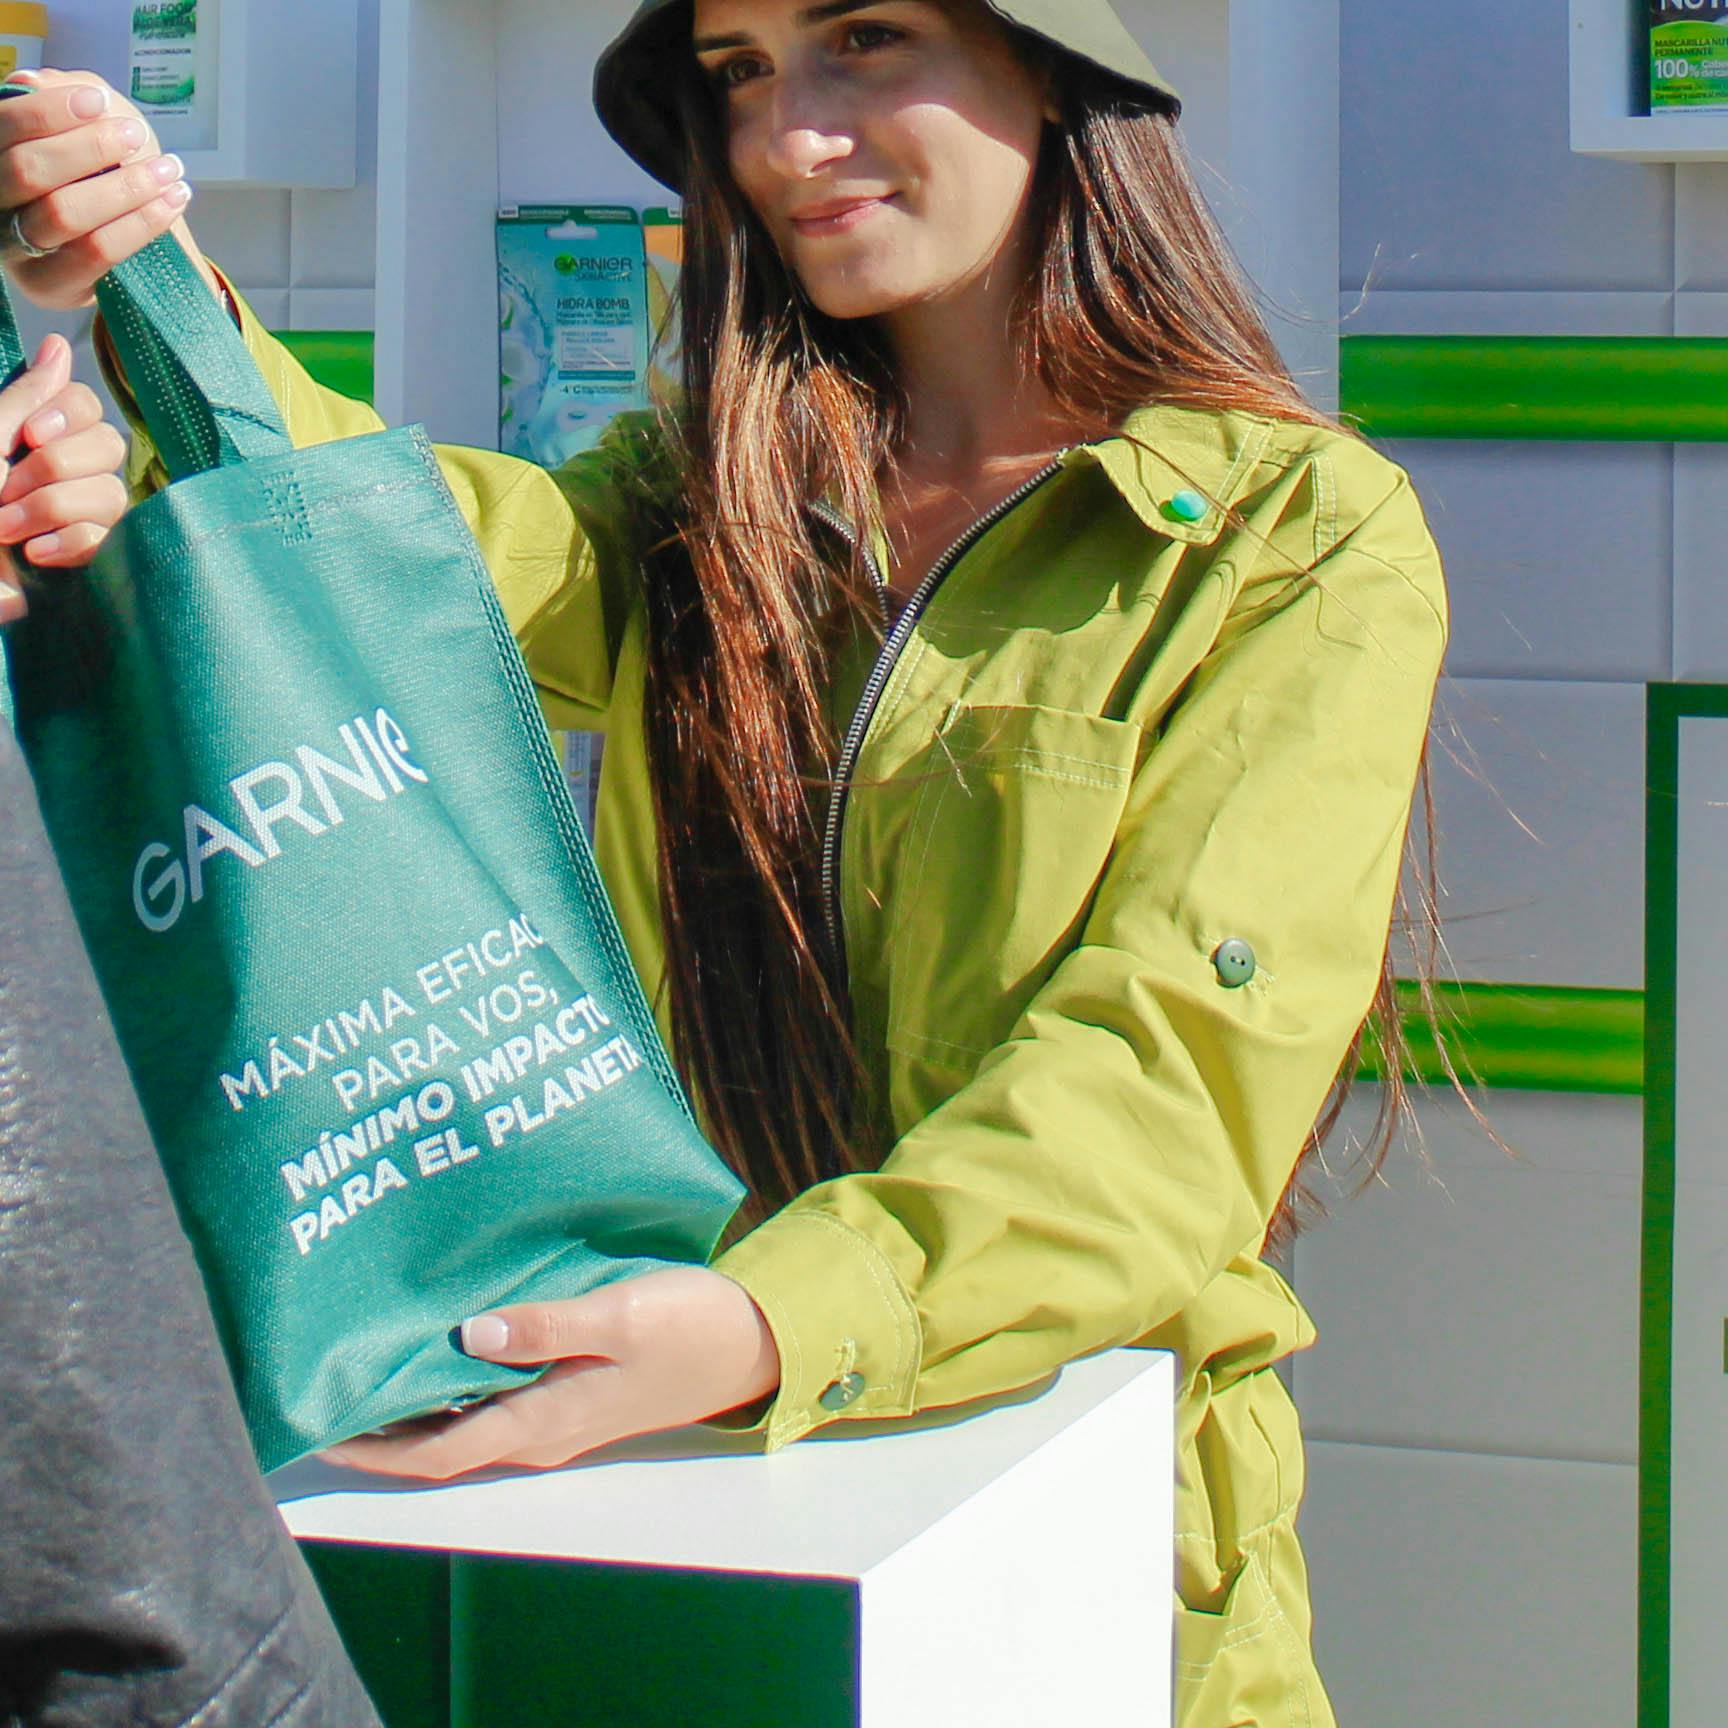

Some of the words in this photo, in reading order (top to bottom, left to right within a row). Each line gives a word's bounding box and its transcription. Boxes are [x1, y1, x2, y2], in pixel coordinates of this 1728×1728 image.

[554, 257, 632, 271] GARNIER
[557, 298, 594, 310] HIDRA
[595, 298, 630, 310] BOMB
[219, 985, 415, 1111] MÁXIMA
[332, 1023, 460, 1111] PARA
[459, 970, 559, 1037] VOS,
[279, 1080, 455, 1201] MÍNIMO
[289, 1157, 408, 1256] PARA
[414, 1127, 480, 1177] EL
